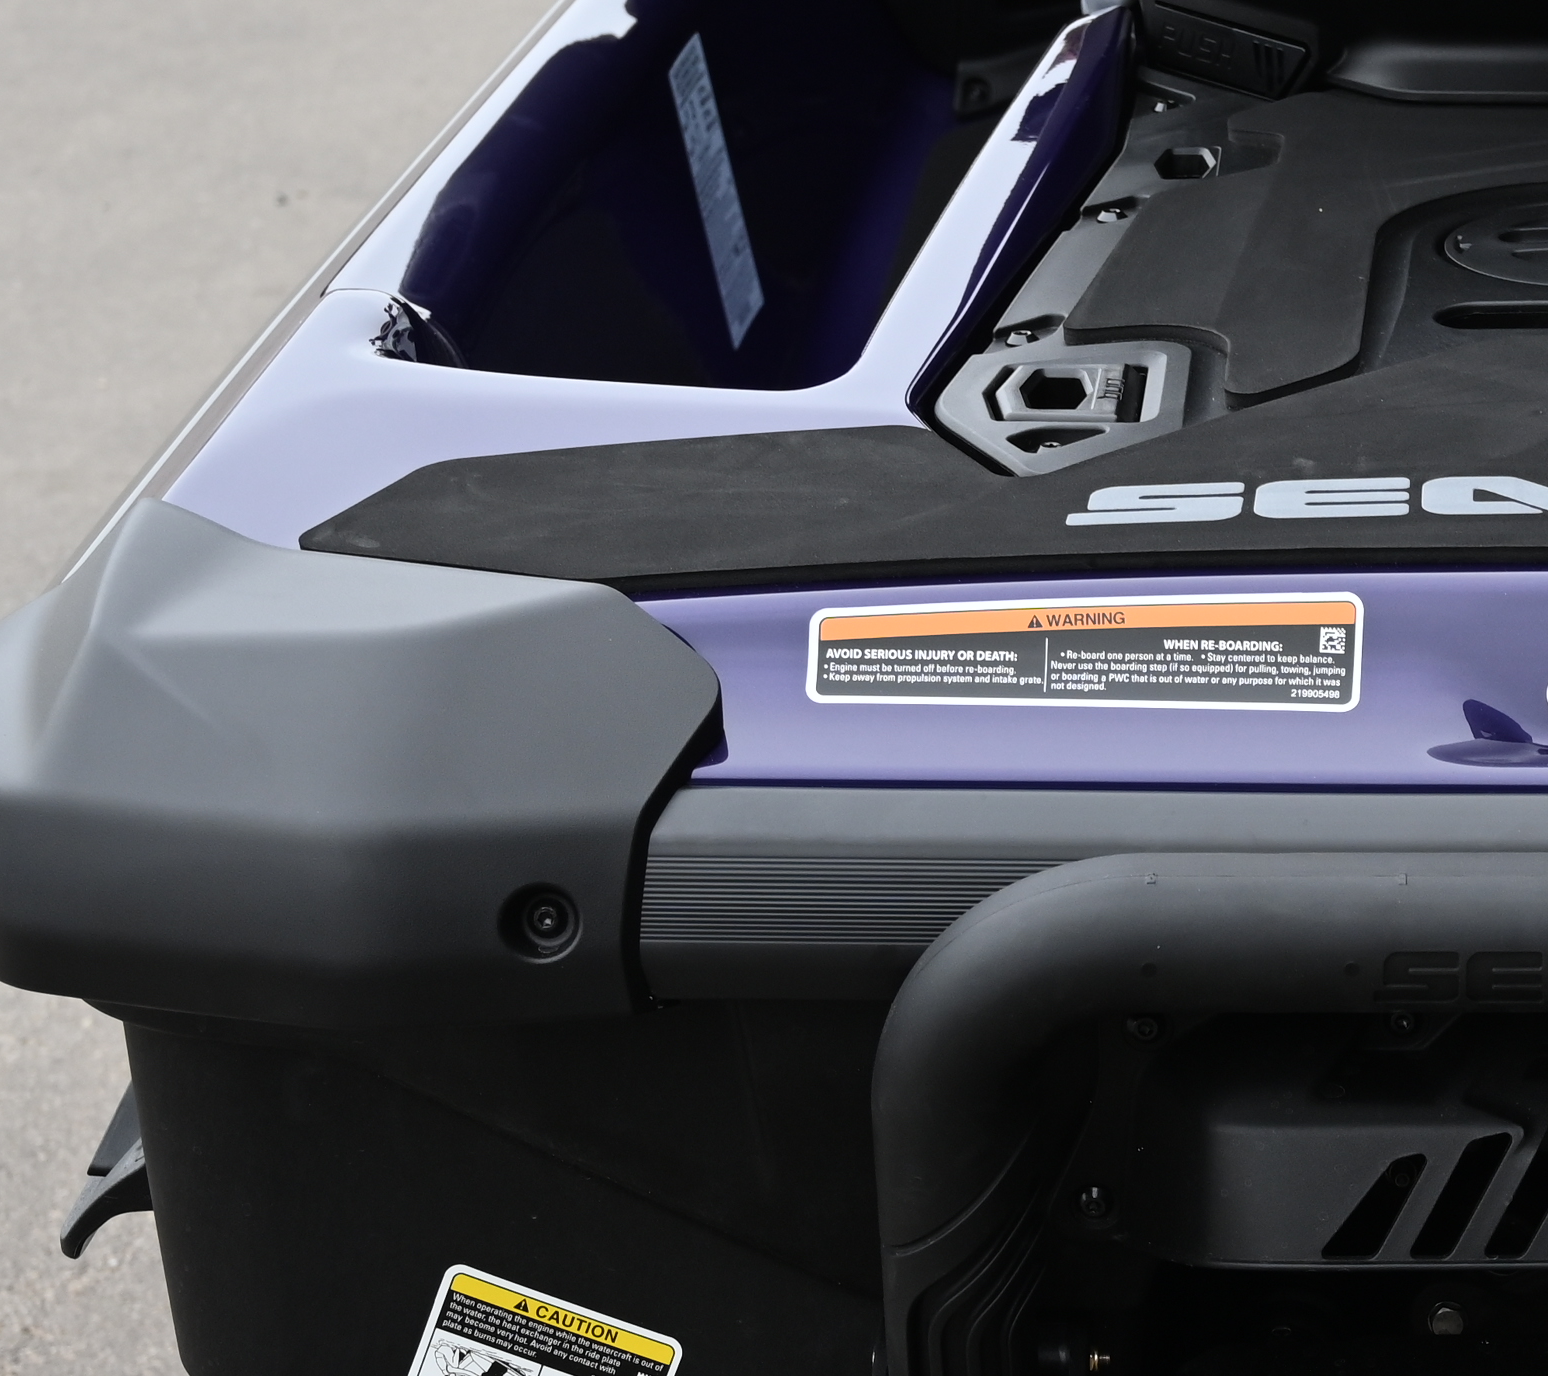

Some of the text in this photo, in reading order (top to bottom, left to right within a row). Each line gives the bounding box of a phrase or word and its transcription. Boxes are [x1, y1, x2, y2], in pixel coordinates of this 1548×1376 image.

[1047, 612, 1125, 626] WARNING
[1164, 639, 1283, 651] WHEN RE-BOARDING:
[826, 649, 1017, 661] AVOID SERIOUS INJURY OR DEATH:
[1066, 650, 1105, 660] Re-board
[1107, 652, 1122, 660] one
[1125, 652, 1154, 662] person
[1156, 652, 1164, 660] at
[1174, 652, 1193, 661] time.
[1207, 653, 1334, 664] Stay centered to keep balance.
[830, 663, 1016, 675] Engine must be turned off before re-boarding.
[1051, 660, 1076, 670] Never
[1078, 662, 1093, 670] use
[1095, 661, 1108, 670] the
[1110, 662, 1147, 672] boarding
[1150, 663, 1167, 673] step
[1170, 663, 1178, 672] (if
[1192, 664, 1233, 673] equipped)
[1235, 664, 1247, 673] for
[1249, 664, 1278, 675] pulling,
[1281, 665, 1311, 675] towing,
[1313, 666, 1346, 676] jumping
[829, 673, 1044, 685] Keep away from propulsion system and intake grate.
[1062, 672, 1098, 682] boarding
[1109, 673, 1129, 682] PWC
[1131, 673, 1148, 682] that
[1150, 674, 1157, 682] is
[1159, 674, 1172, 683] out
[1174, 675, 1183, 683] of
[1185, 675, 1209, 684] water
[1222, 677, 1236, 686] any
[1239, 677, 1272, 685] purpose
[1275, 677, 1286, 685] for
[1288, 677, 1313, 686] which
[1051, 682, 1106, 692] not designed.
[536, 1305, 618, 1343] CAUTION
[443, 1320, 462, 1330] plate
[474, 1329, 496, 1342] burns
[496, 1339, 512, 1349] may
[514, 1346, 537, 1358] occur.
[449, 1302, 621, 1367] the water, the heat exchanger in the ride plate
[453, 1292, 664, 1372] When operating the engine while the watercraft is out of
[446, 1311, 616, 1375] may become very hot. Avoid any contact with
